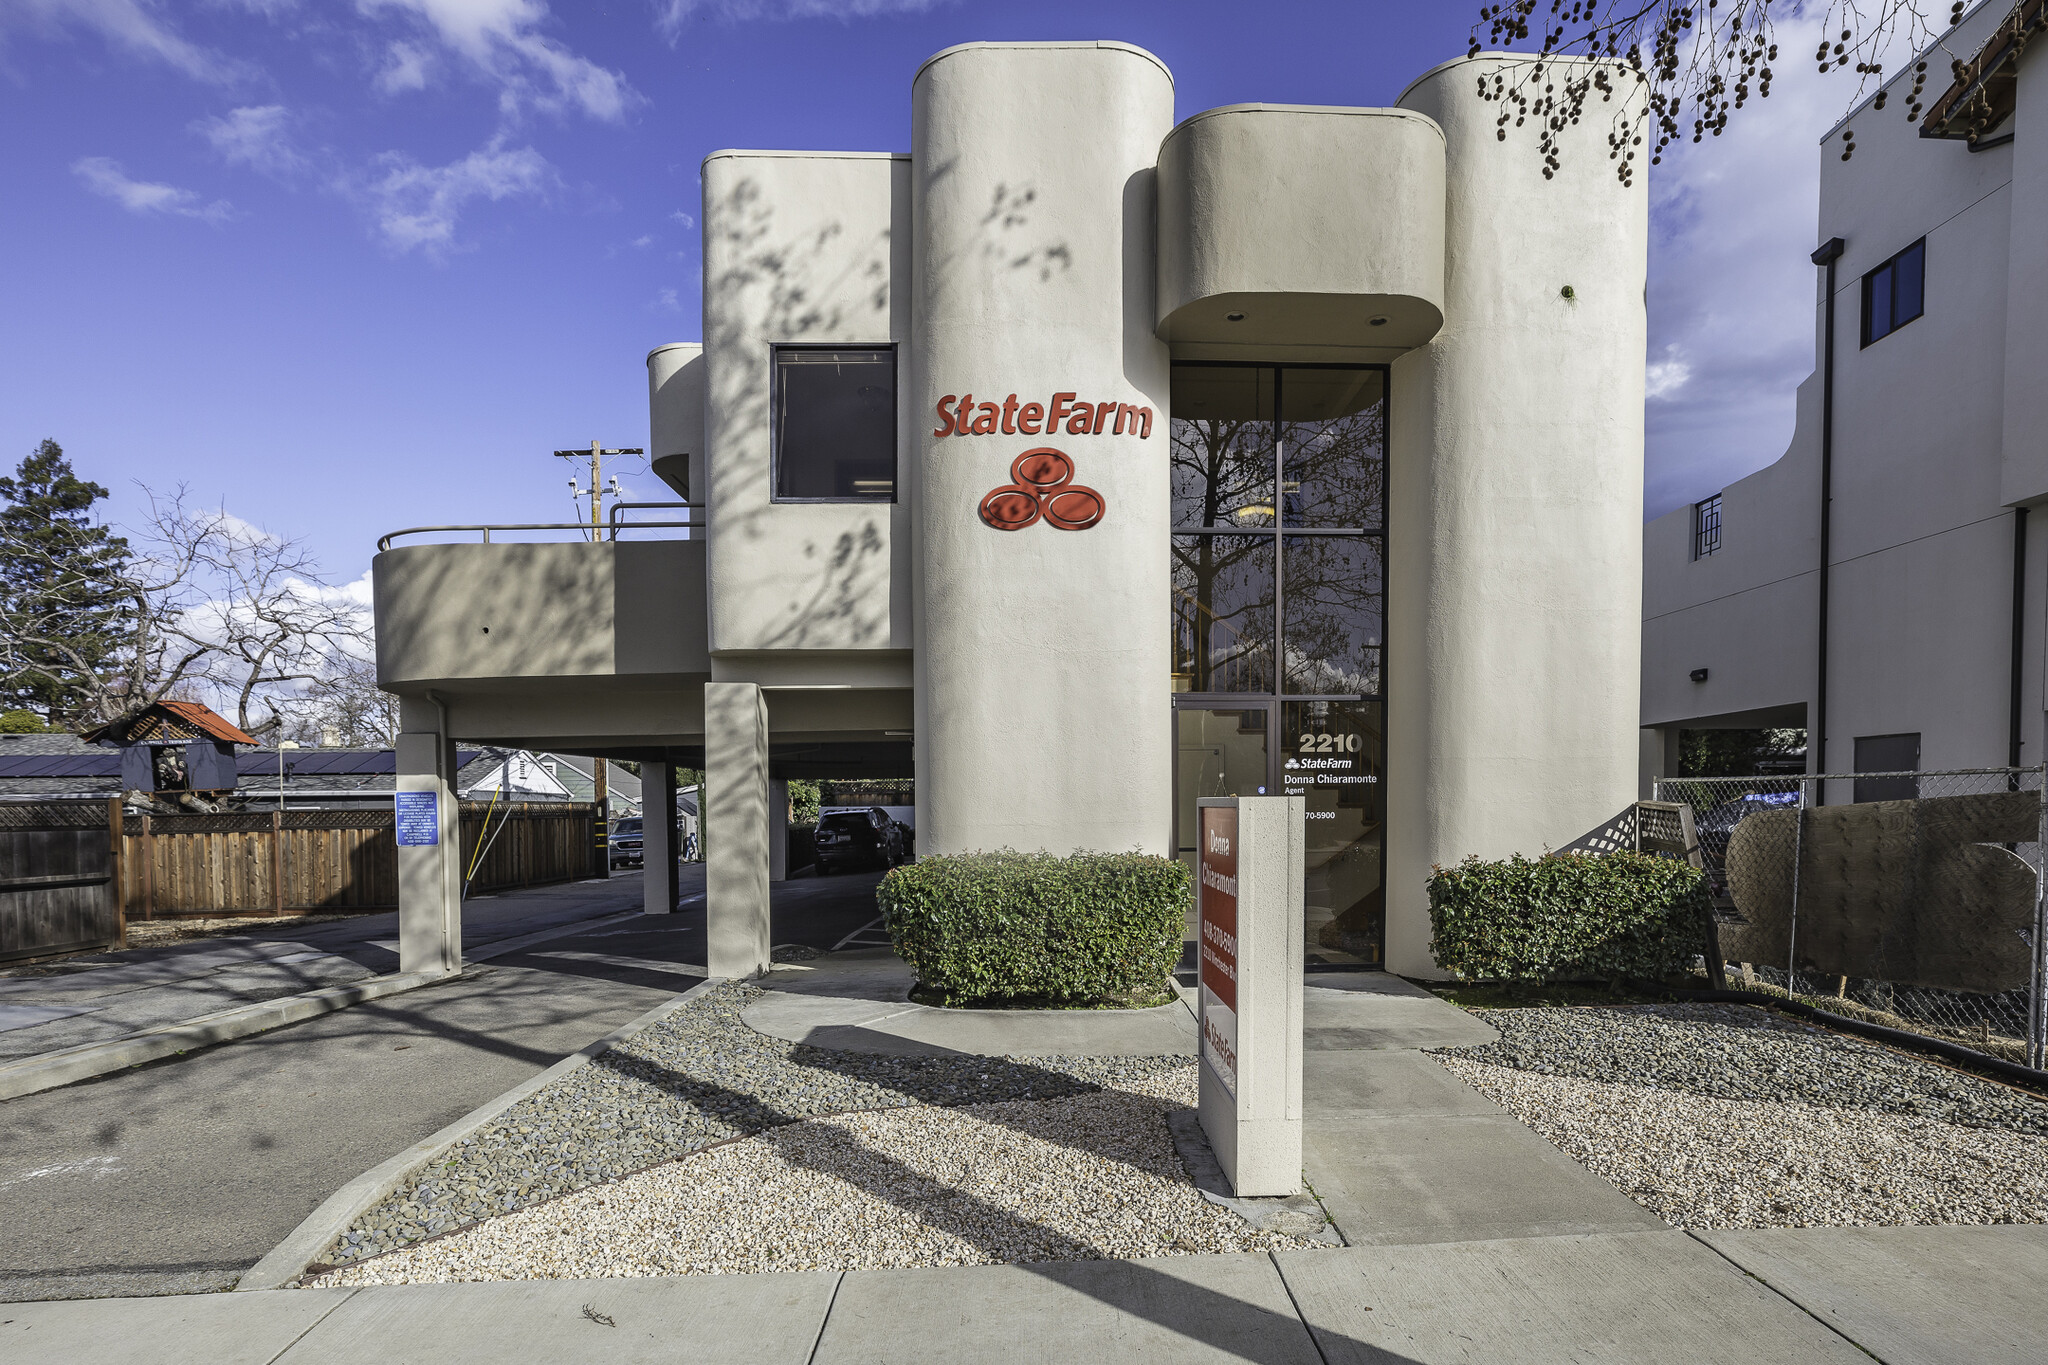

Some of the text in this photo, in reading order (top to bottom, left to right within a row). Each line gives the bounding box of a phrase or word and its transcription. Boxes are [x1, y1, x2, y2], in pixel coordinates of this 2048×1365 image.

[1299, 733, 1362, 753] 2210
[1284, 774, 1378, 785] Donna Chiaramonte
[1284, 787, 1305, 795] Agent
[1210, 829, 1230, 857] Donna
[1202, 861, 1237, 898] Chiaramont
